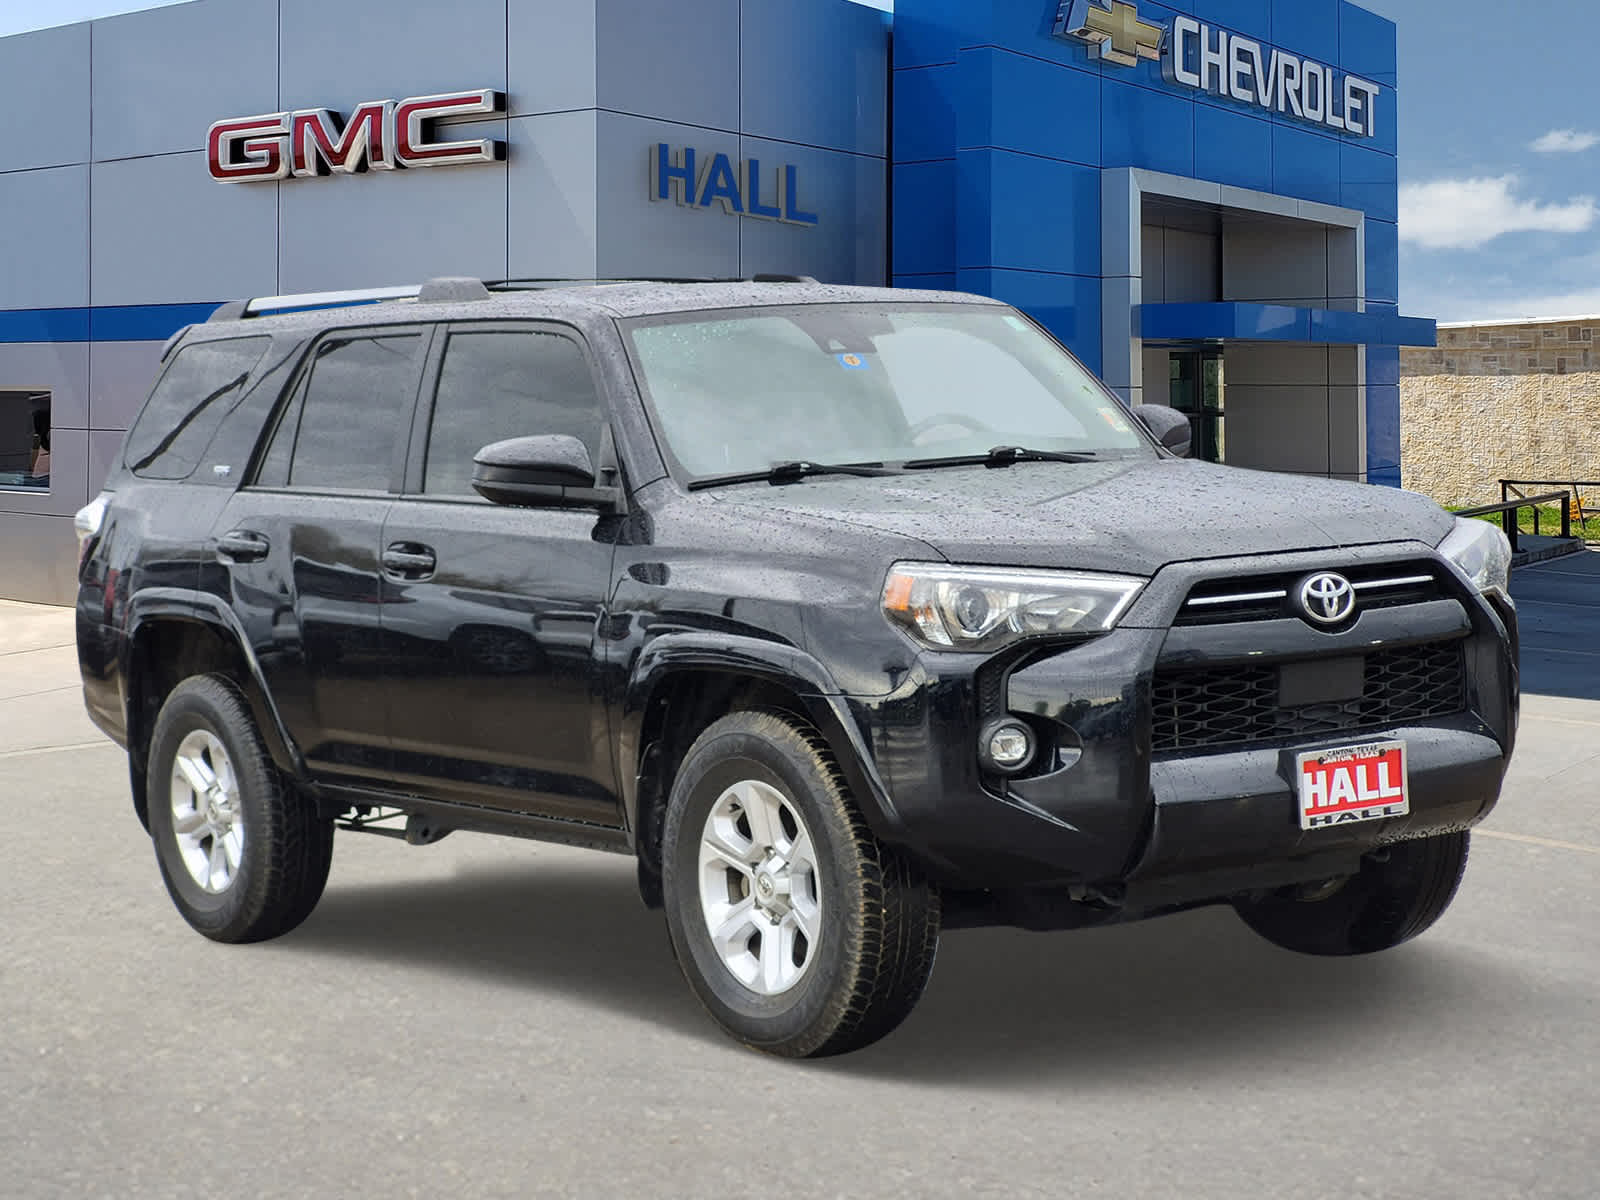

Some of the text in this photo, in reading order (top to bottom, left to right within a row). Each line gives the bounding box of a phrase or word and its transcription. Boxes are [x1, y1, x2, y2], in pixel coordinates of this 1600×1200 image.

[1174, 16, 1379, 137] CHEVROLET
[208, 88, 505, 184] GMC
[652, 142, 819, 226] HALL
[1303, 761, 1402, 809] HALL
[1310, 806, 1403, 826] HALL
